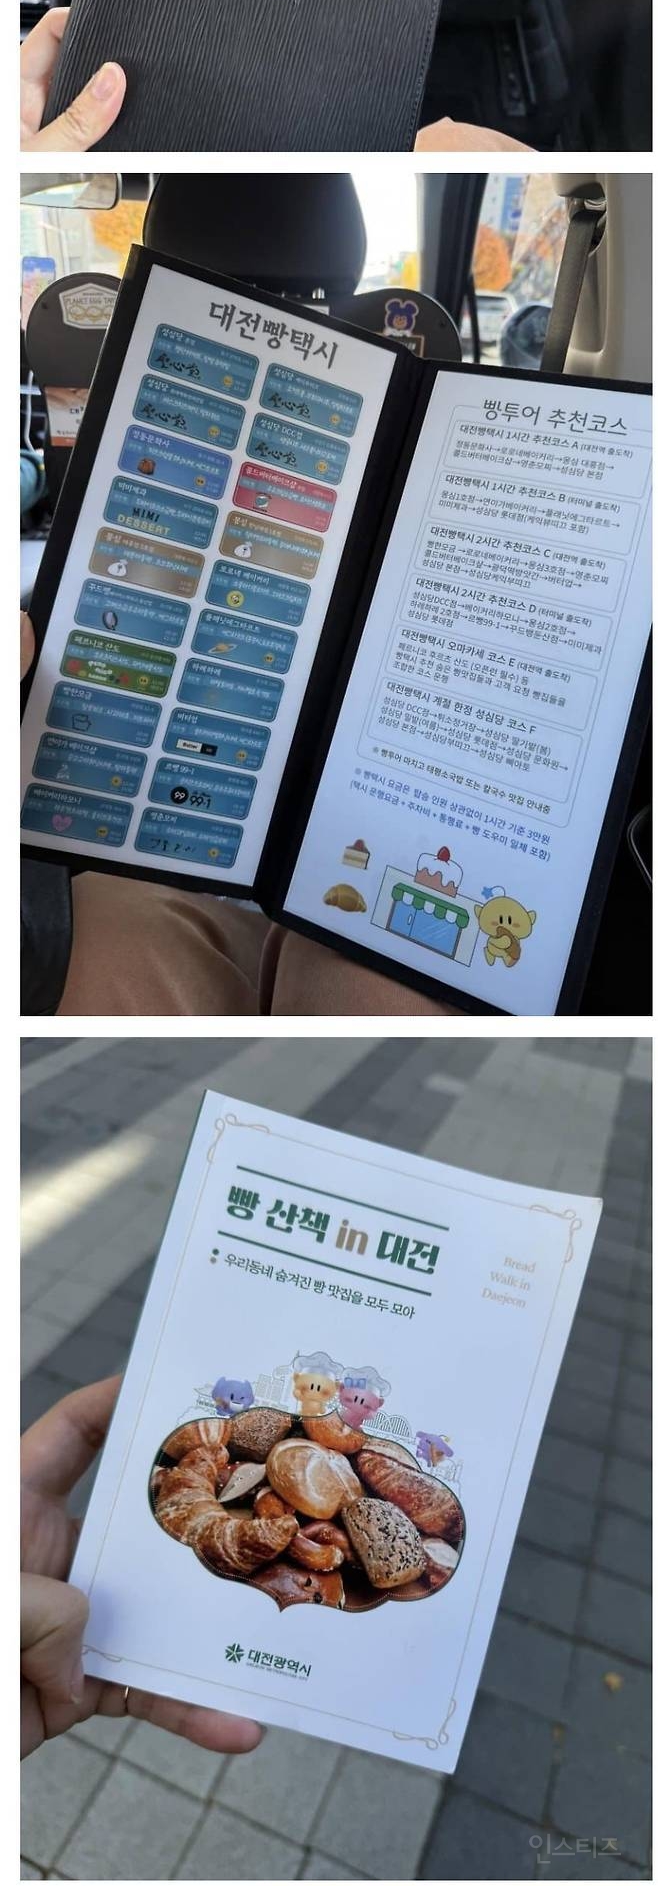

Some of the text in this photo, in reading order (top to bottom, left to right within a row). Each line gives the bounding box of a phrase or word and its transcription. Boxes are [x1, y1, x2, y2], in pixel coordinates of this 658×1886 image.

[208, 302, 339, 369] 대전빵택시
[483, 399, 628, 436] 빵투어 추천코스
[460, 424, 504, 439] 대전빵택시
[506, 430, 530, 443] 1시간
[532, 435, 569, 448] 추천코스
[227, 1185, 440, 1275] 빵 산책 in 대전
[503, 1256, 536, 1273] Bread
[224, 1253, 416, 1320] 우리동네 숨겨진 빵 맛집을 모두 모아
[490, 1271, 517, 1287] Walk
[481, 1287, 527, 1308] Daejeon
[248, 1649, 312, 1677] 대전광역시
